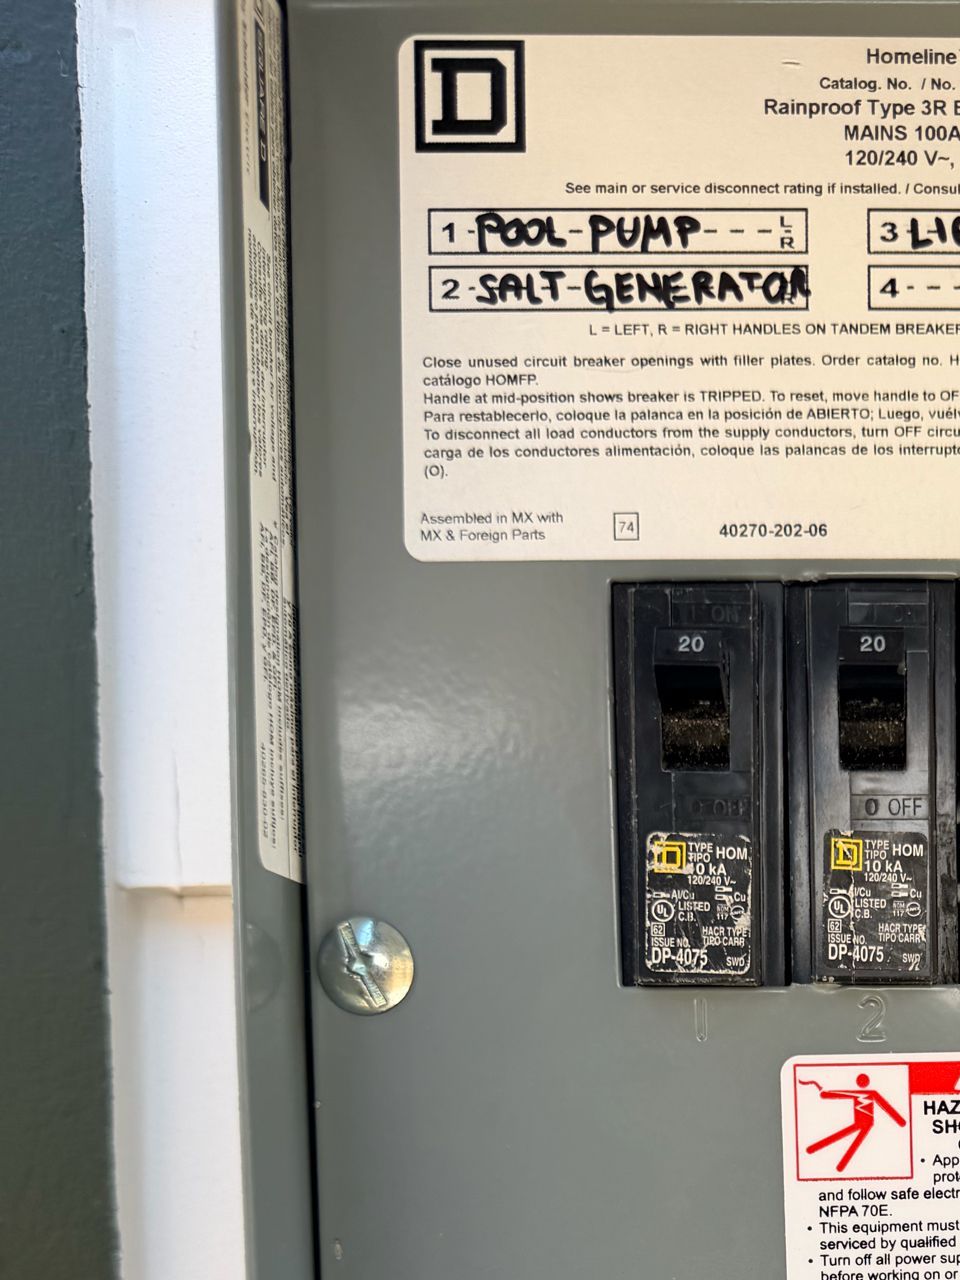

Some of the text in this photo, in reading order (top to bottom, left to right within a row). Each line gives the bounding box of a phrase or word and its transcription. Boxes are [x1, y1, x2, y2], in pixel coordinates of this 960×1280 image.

[819, 77, 881, 93] Catalog.
[887, 78, 911, 90] No.
[921, 78, 926, 90] /
[931, 78, 955, 90] No.
[764, 99, 862, 119] Rainproof
[867, 99, 915, 120] Type
[921, 100, 947, 116] 3R
[845, 125, 907, 141] MAINS
[442, 222, 455, 243] 1
[588, 214, 700, 253] PUMP
[881, 223, 899, 242] 3
[441, 279, 460, 299] 2
[476, 270, 567, 305] SALT
[881, 278, 900, 298] 4
[421, 511, 563, 524] Assembled in MX with
[420, 528, 546, 543] MX & Foreign Parts
[619, 521, 634, 533] 74
[719, 523, 827, 537] 40270-202-06
[678, 635, 705, 652] 20
[860, 635, 886, 652] 20
[888, 797, 922, 816] OFF
[716, 846, 748, 860] HOM
[892, 844, 924, 857] HOM
[651, 947, 708, 966] DP-4075
[828, 943, 884, 963] DP-4075
